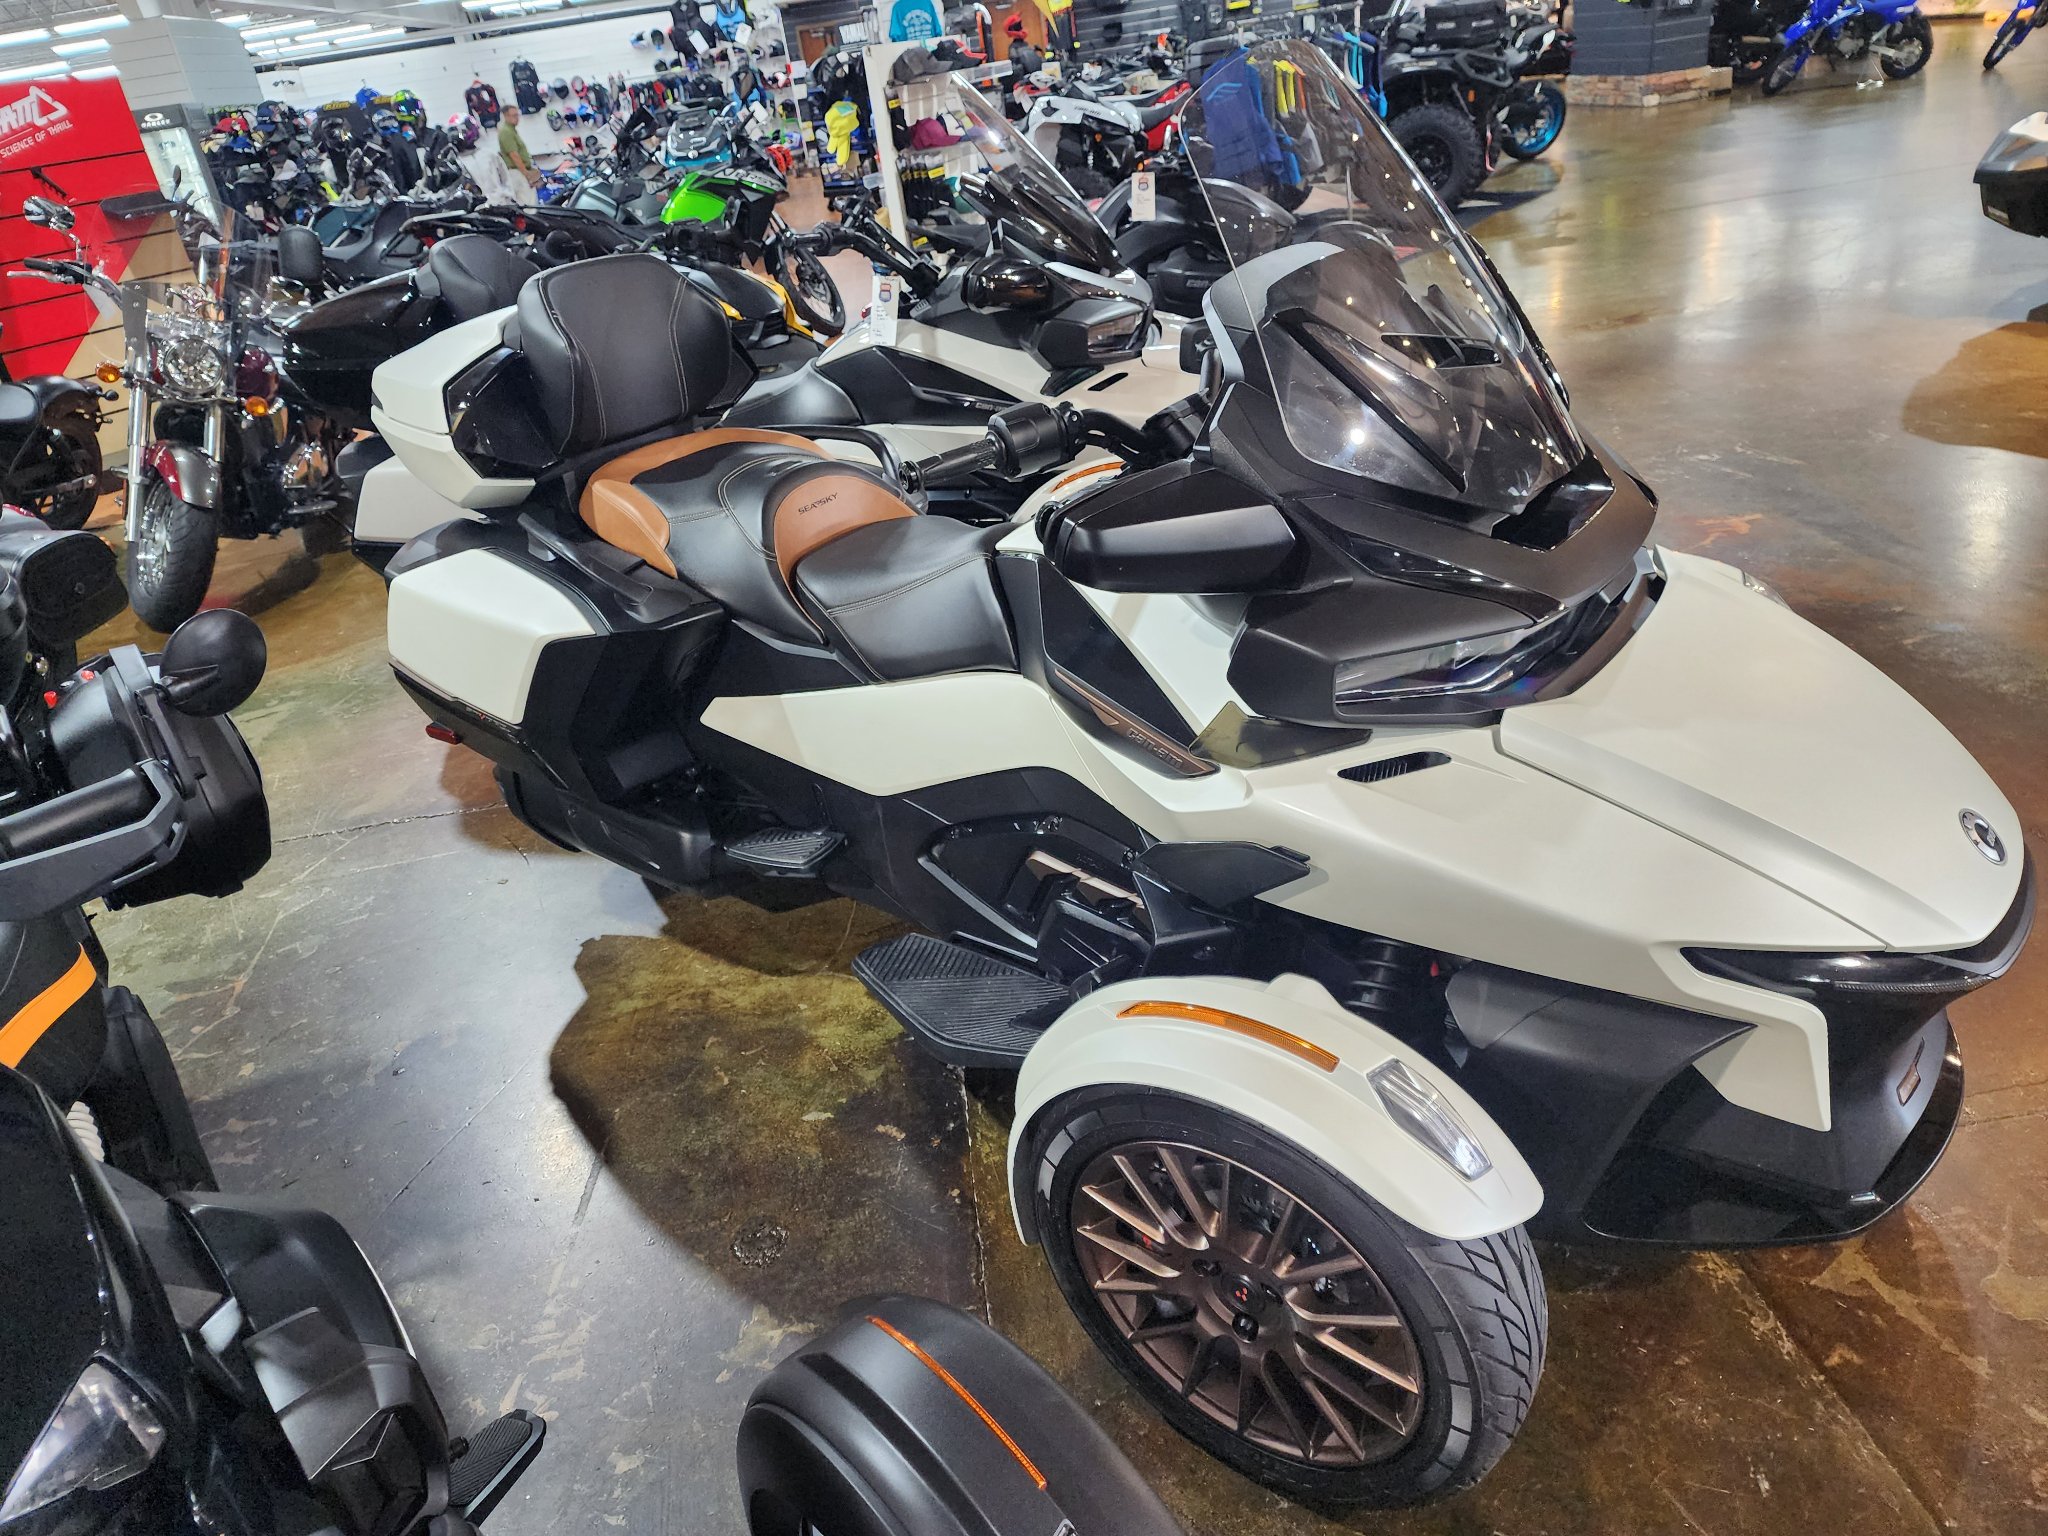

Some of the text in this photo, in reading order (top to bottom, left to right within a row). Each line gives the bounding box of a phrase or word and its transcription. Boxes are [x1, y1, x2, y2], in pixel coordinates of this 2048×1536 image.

[0, 120, 73, 158] SCIENCE OF THRILL
